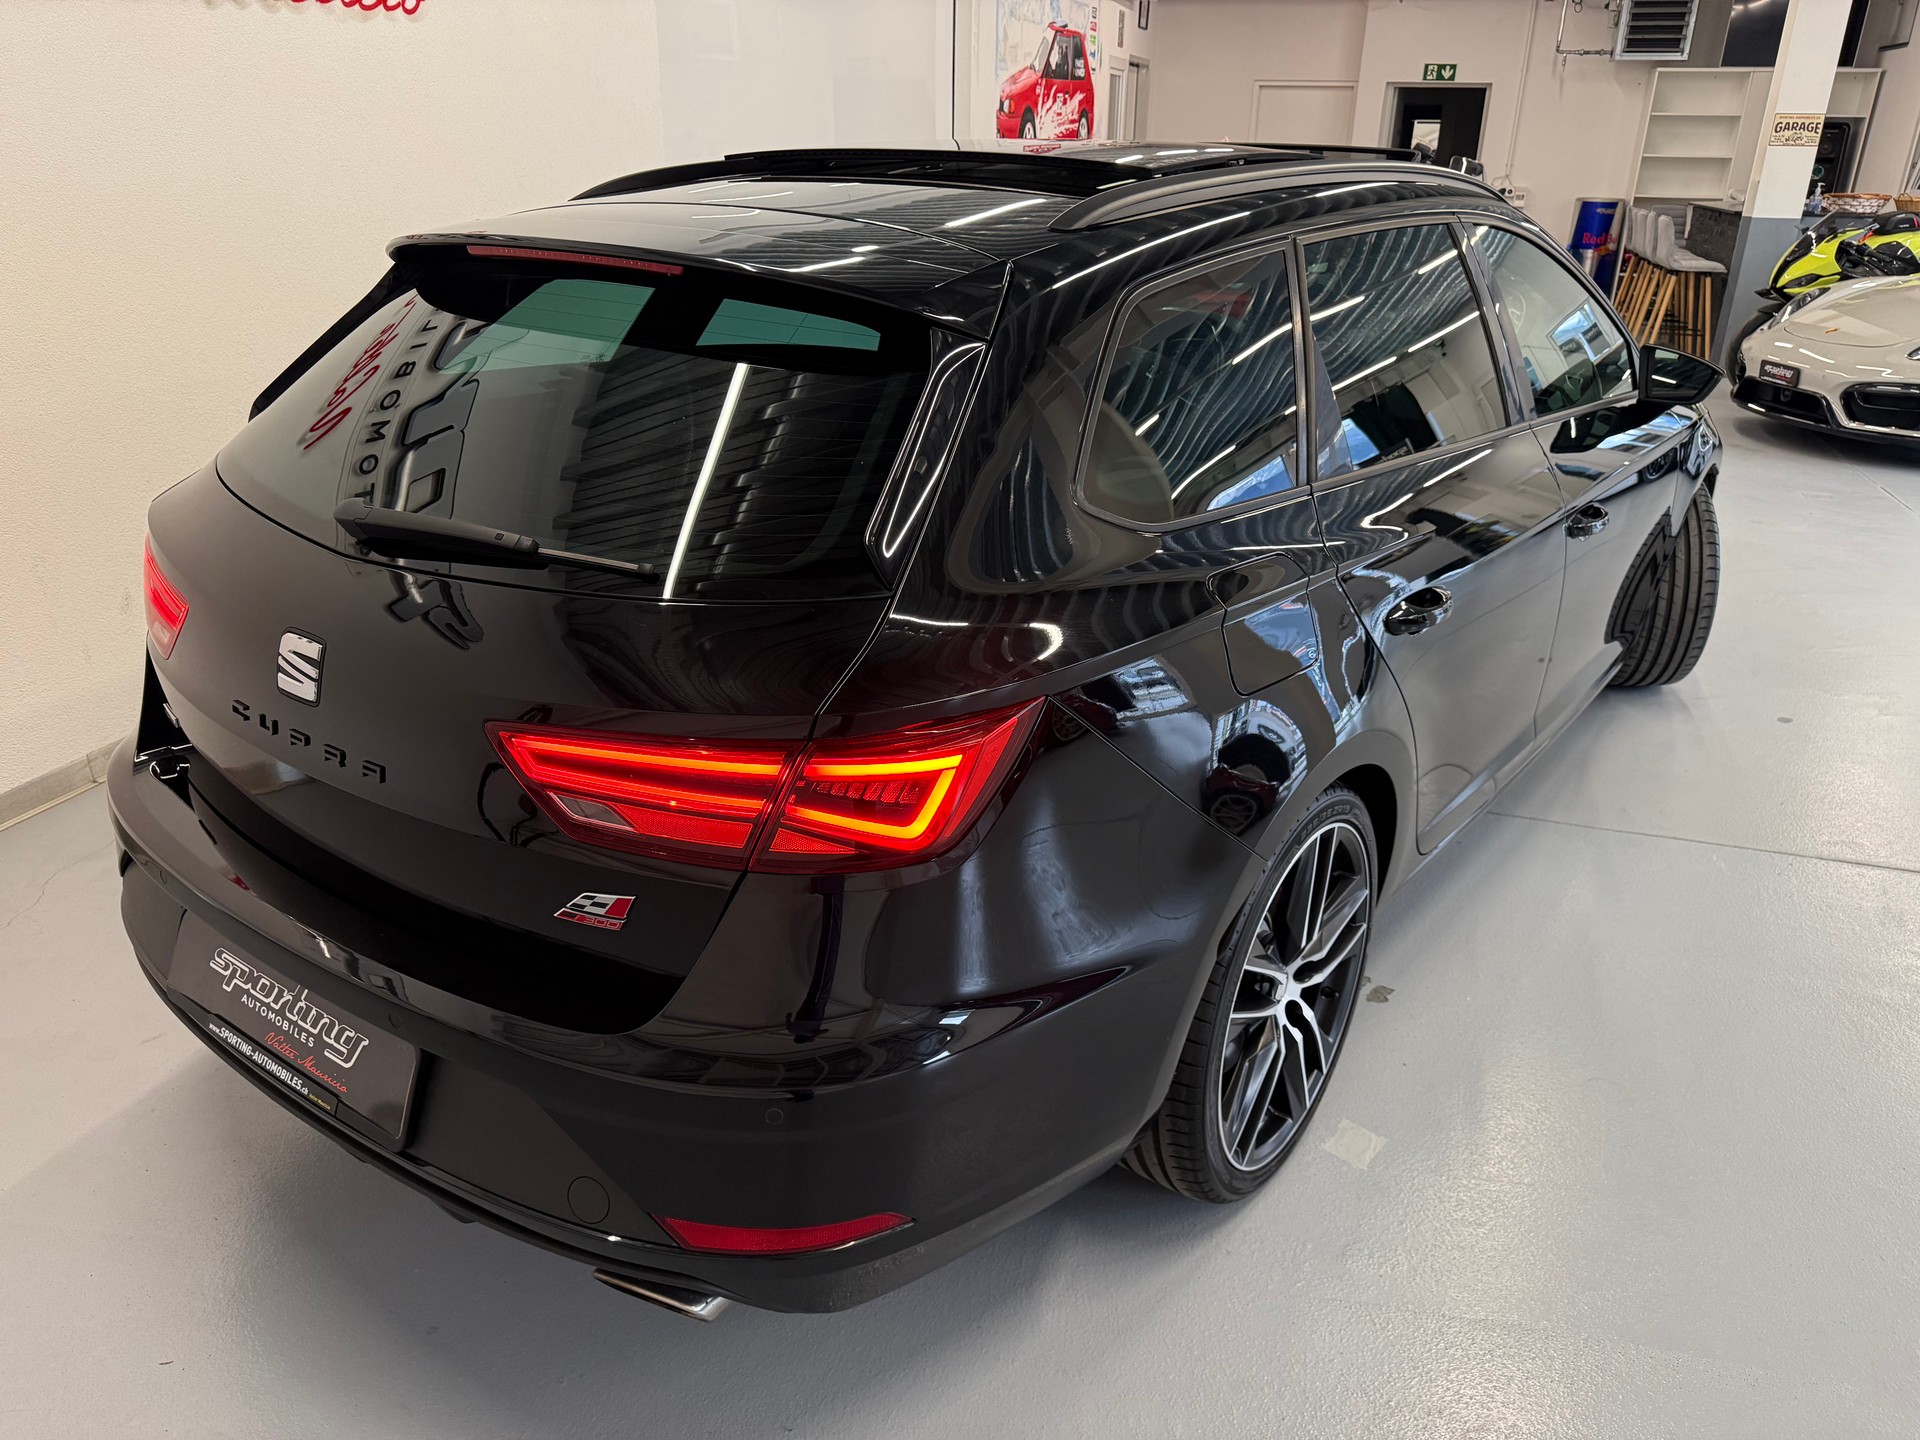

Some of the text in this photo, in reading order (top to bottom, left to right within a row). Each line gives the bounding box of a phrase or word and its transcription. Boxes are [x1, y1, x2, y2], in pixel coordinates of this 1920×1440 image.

[1774, 121, 1821, 135] GARAGE
[1583, 232, 1606, 244] Red
[231, 699, 387, 784] CUPRA
[583, 917, 620, 928] 300
[241, 994, 315, 1047] AUTOMOBILES
[208, 1021, 309, 1095] www.SPORTING-AUTOMOBILES.ch
